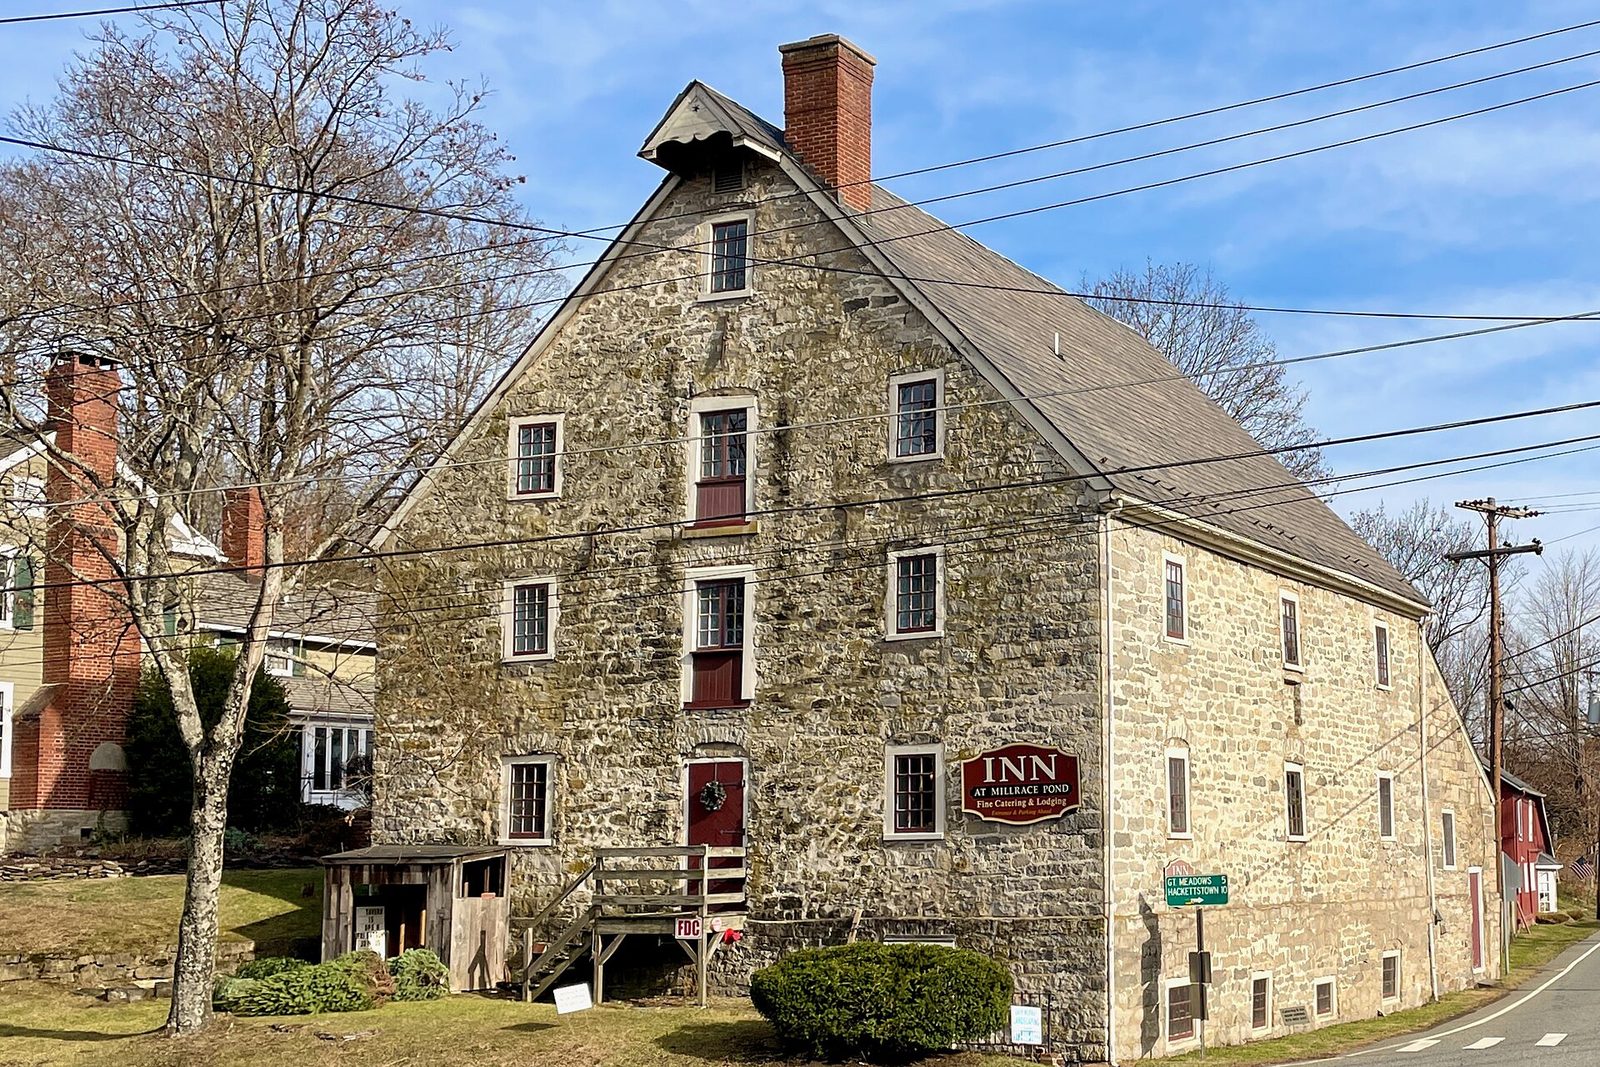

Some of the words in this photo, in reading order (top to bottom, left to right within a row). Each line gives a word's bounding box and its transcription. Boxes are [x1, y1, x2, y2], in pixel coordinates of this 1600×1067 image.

[983, 754, 1057, 783] INN
[974, 788, 986, 797] AT
[991, 785, 1039, 796] MILLRACE
[1043, 784, 1069, 794] POND
[994, 799, 1027, 808] Catering
[1036, 797, 1067, 806] Lodging
[1172, 865, 1189, 876] INN
[1167, 878, 1177, 887] GT
[1179, 877, 1212, 886] MEADOWS
[1221, 876, 1227, 885] 5
[1167, 886, 1219, 896] HACKETTSTOWN
[1221, 886, 1228, 894] 10
[677, 920, 700, 936] FDC
